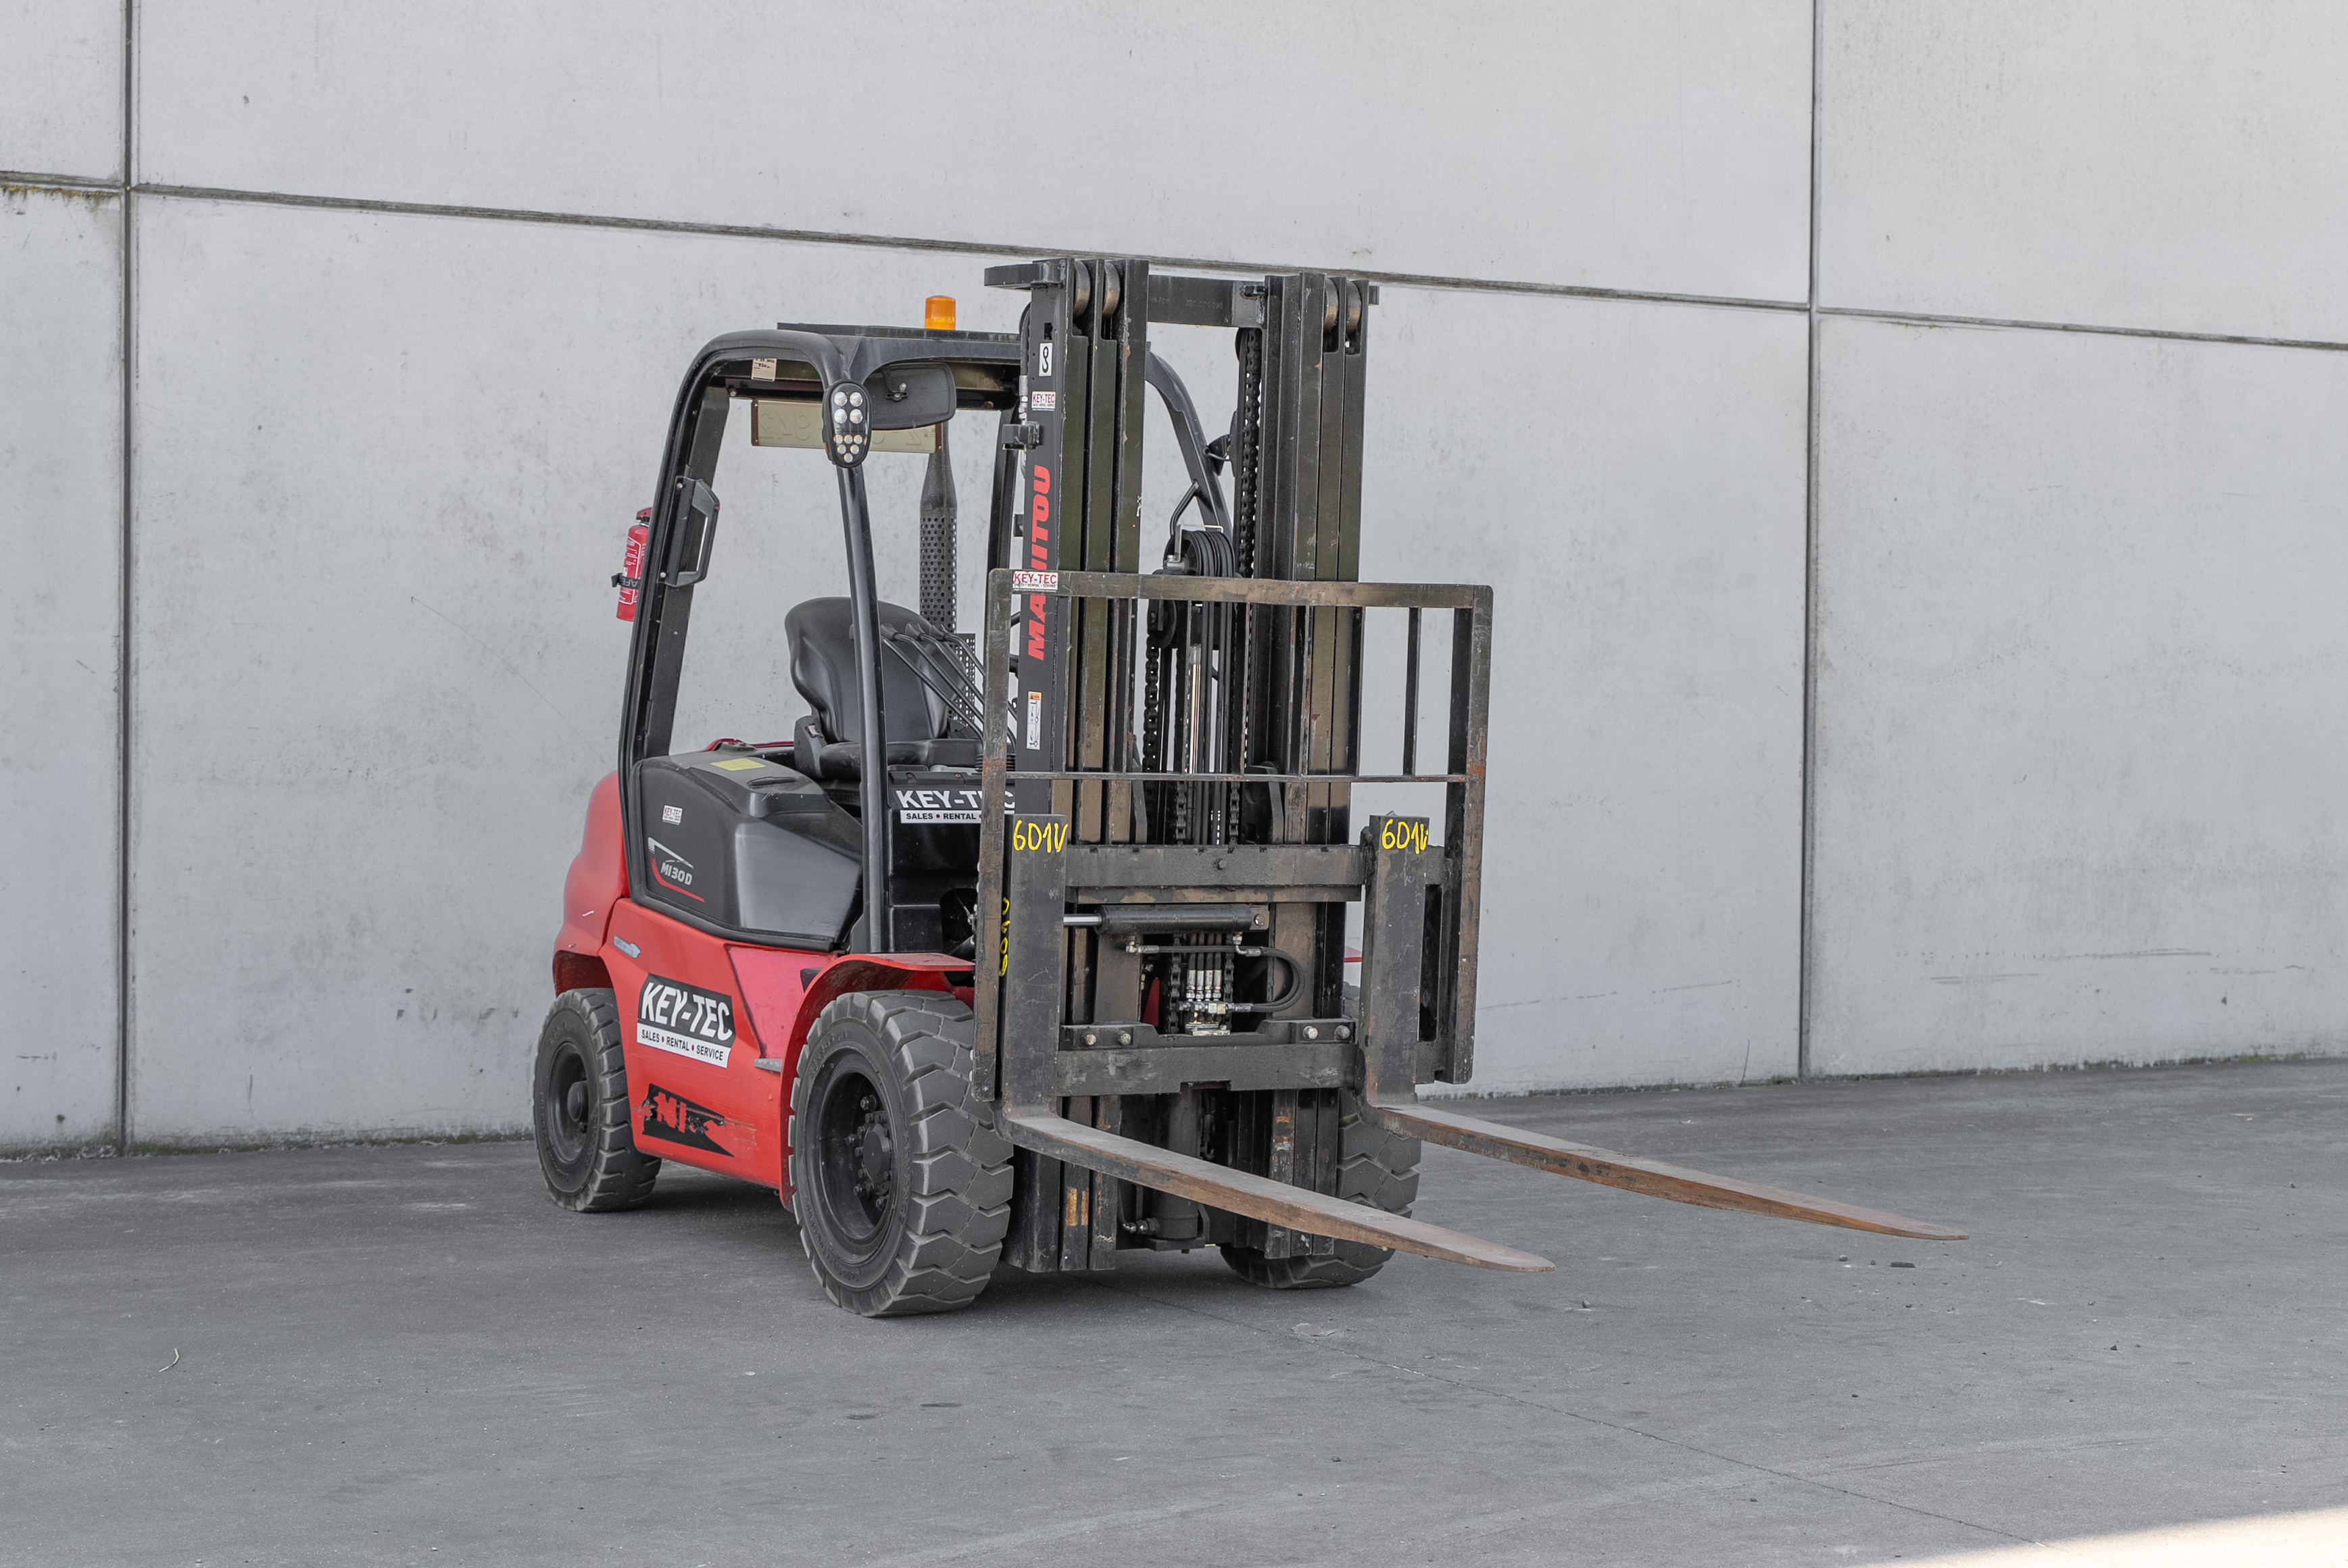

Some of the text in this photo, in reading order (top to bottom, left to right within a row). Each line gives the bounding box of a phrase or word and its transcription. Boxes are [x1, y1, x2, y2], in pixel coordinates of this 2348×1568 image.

[1033, 393, 1054, 403] KEY-TEC
[1014, 573, 1056, 585] KEY-TEC
[660, 862, 693, 885] MI30D
[641, 982, 733, 1042] KEY-TEC
[641, 1029, 724, 1061] SALES RENTAL SERVICE
